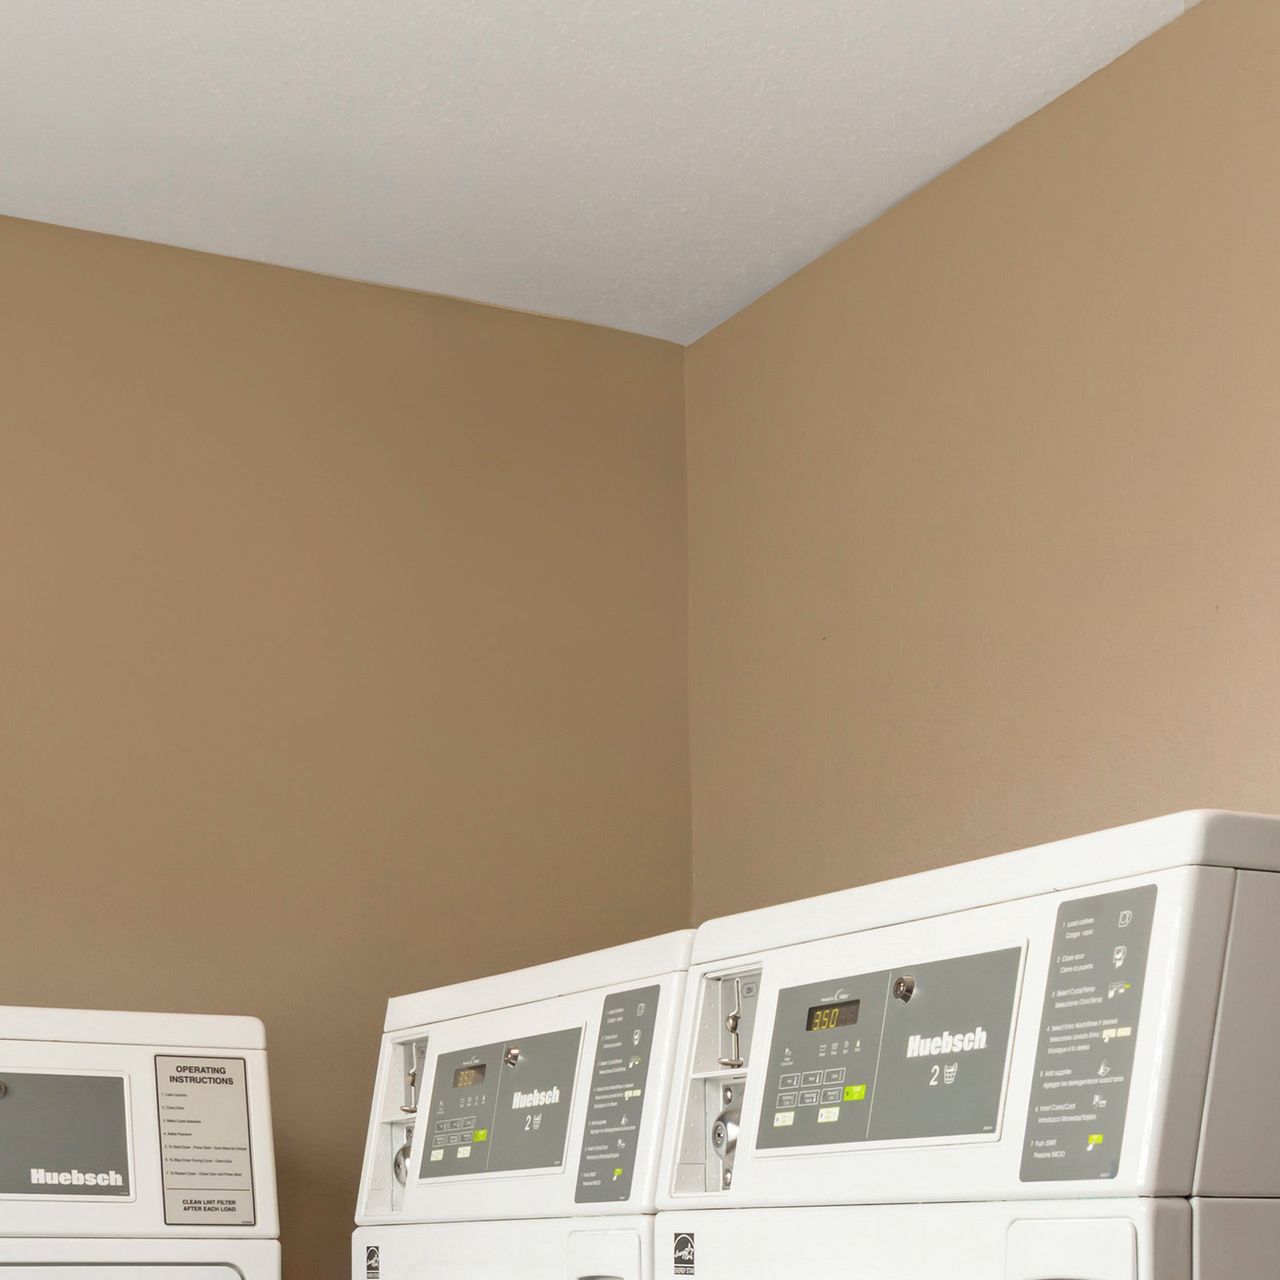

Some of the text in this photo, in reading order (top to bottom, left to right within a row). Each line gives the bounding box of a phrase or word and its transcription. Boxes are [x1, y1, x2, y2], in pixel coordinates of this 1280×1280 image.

[906, 1026, 988, 1058] Huebsch
[175, 1065, 227, 1074] OPERATING
[929, 1065, 940, 1086] 2
[169, 1075, 234, 1085] INSTRUCTIONS
[511, 1086, 560, 1109] Huebsch
[524, 1115, 531, 1131] 2
[30, 1168, 123, 1186] Huebsch
